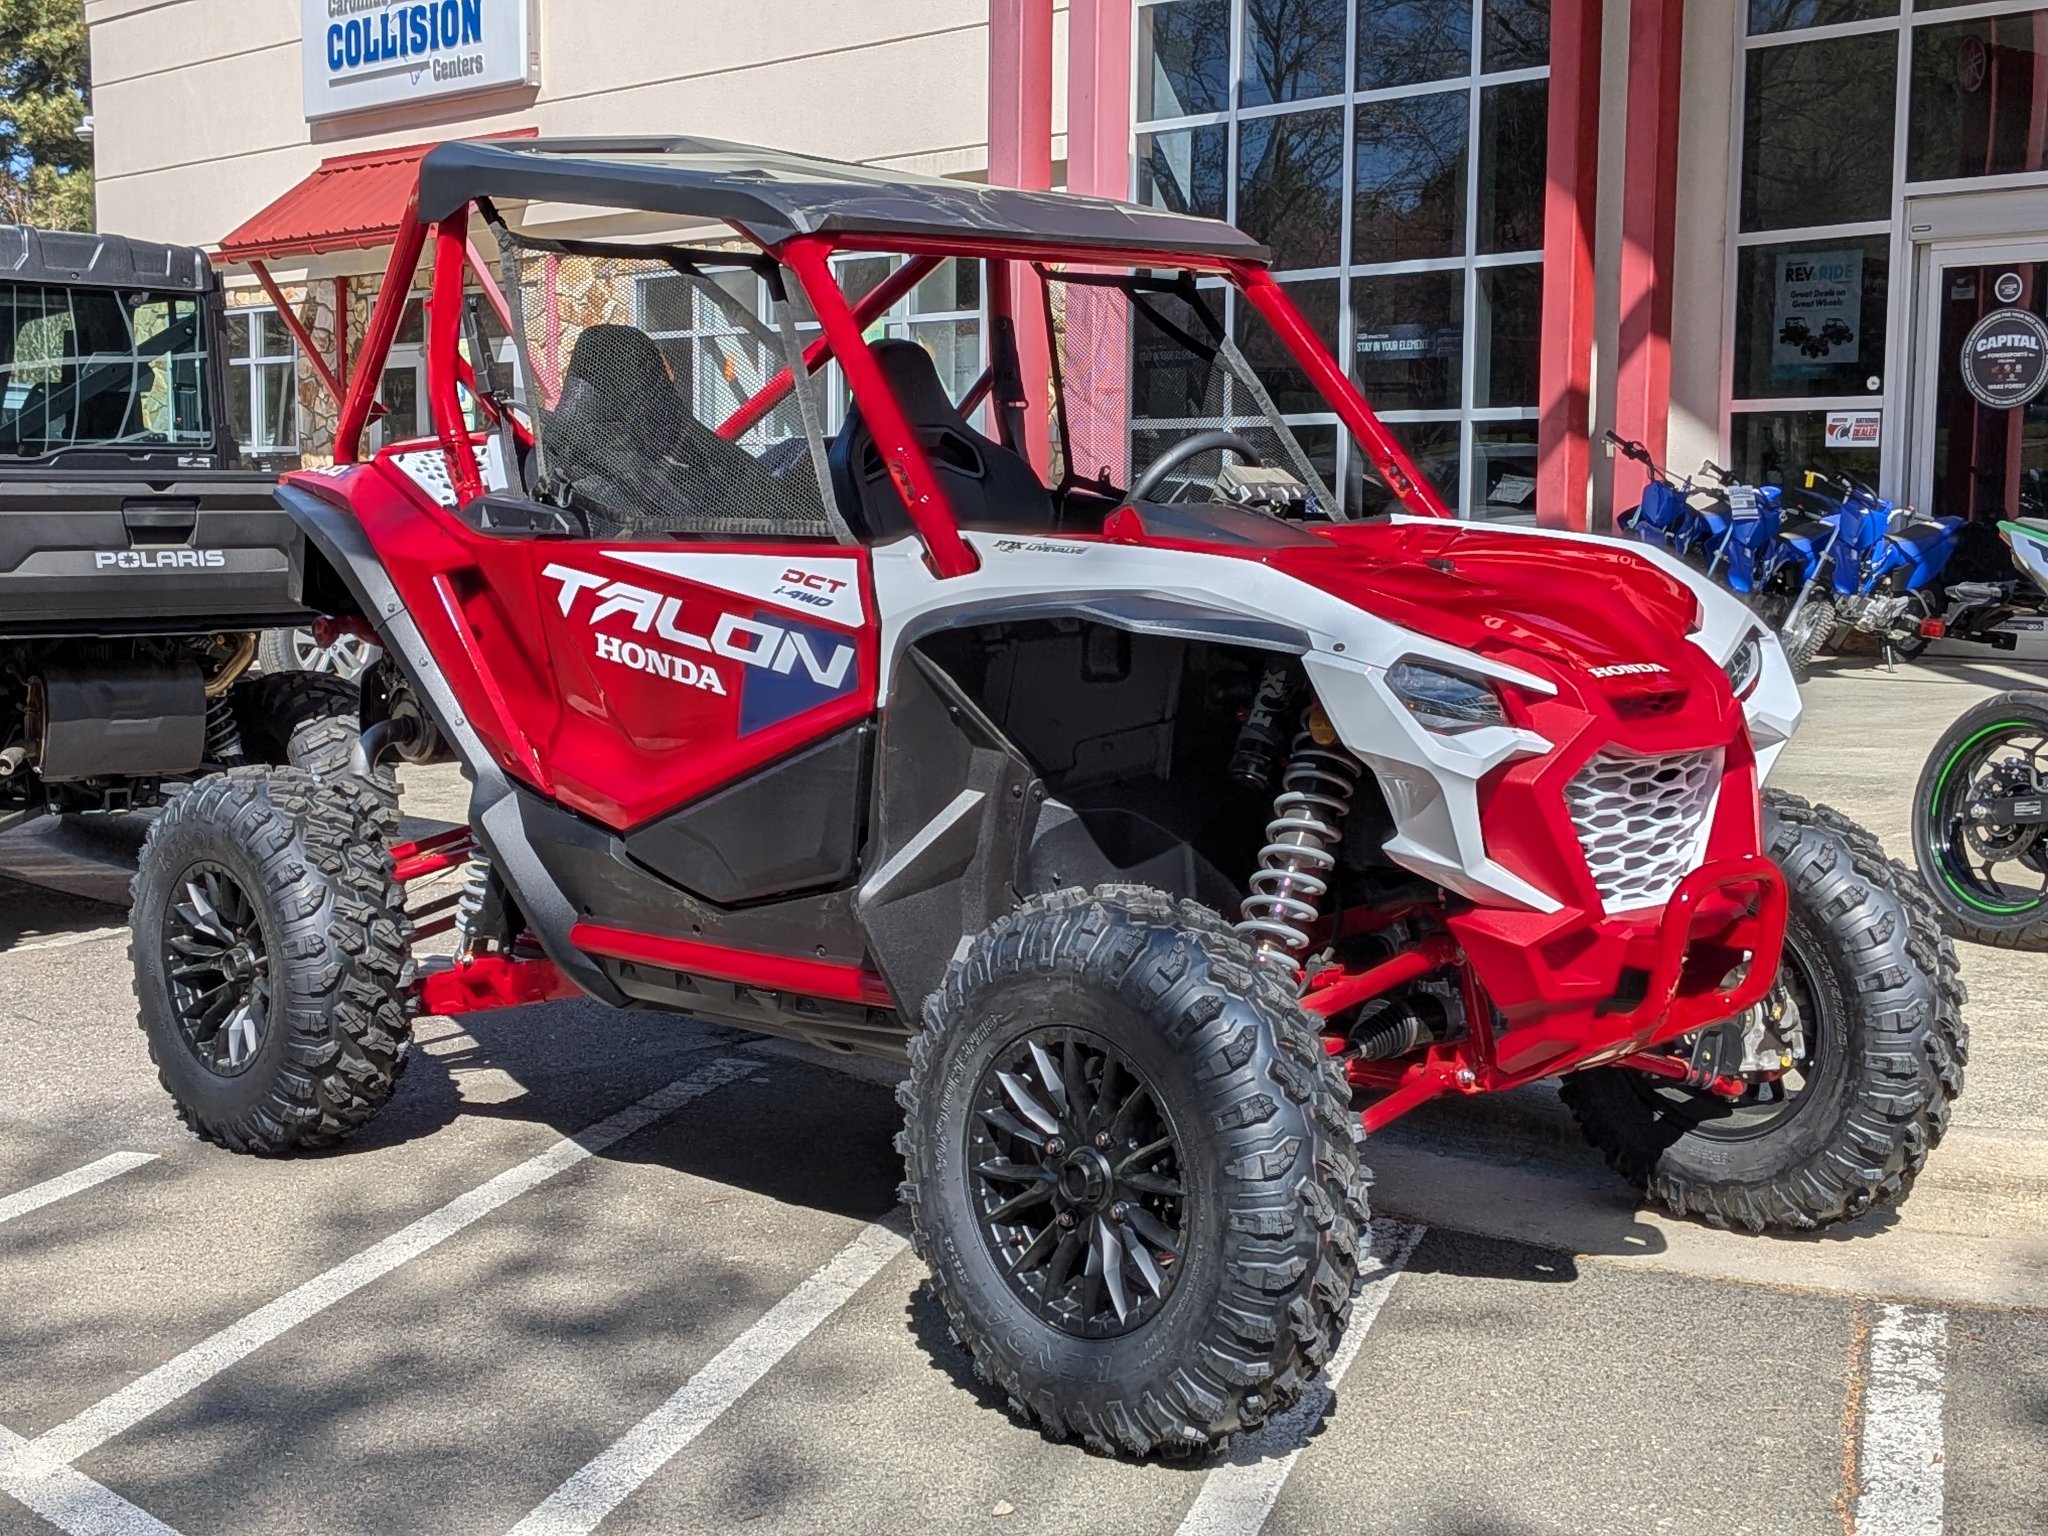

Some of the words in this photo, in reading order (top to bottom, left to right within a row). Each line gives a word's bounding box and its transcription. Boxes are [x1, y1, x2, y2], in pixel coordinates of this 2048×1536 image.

[327, 0, 482, 72] COLLISION
[432, 55, 484, 82] Centers
[1785, 266, 1815, 282] REV
[1356, 341, 1373, 352] STAY
[1373, 341, 1380, 352] IN
[1381, 340, 1398, 351] YOUR
[1399, 339, 1430, 350] ELEMENT
[1976, 334, 2040, 352] CAPITAL
[1852, 428, 1878, 437] DEALER
[95, 550, 226, 569] POLARIS
[781, 568, 848, 594] DCT
[542, 563, 855, 689] TALON
[595, 632, 727, 696] HONDA
[1587, 663, 1671, 679] HONDA
[1247, 669, 1288, 729] FOX
